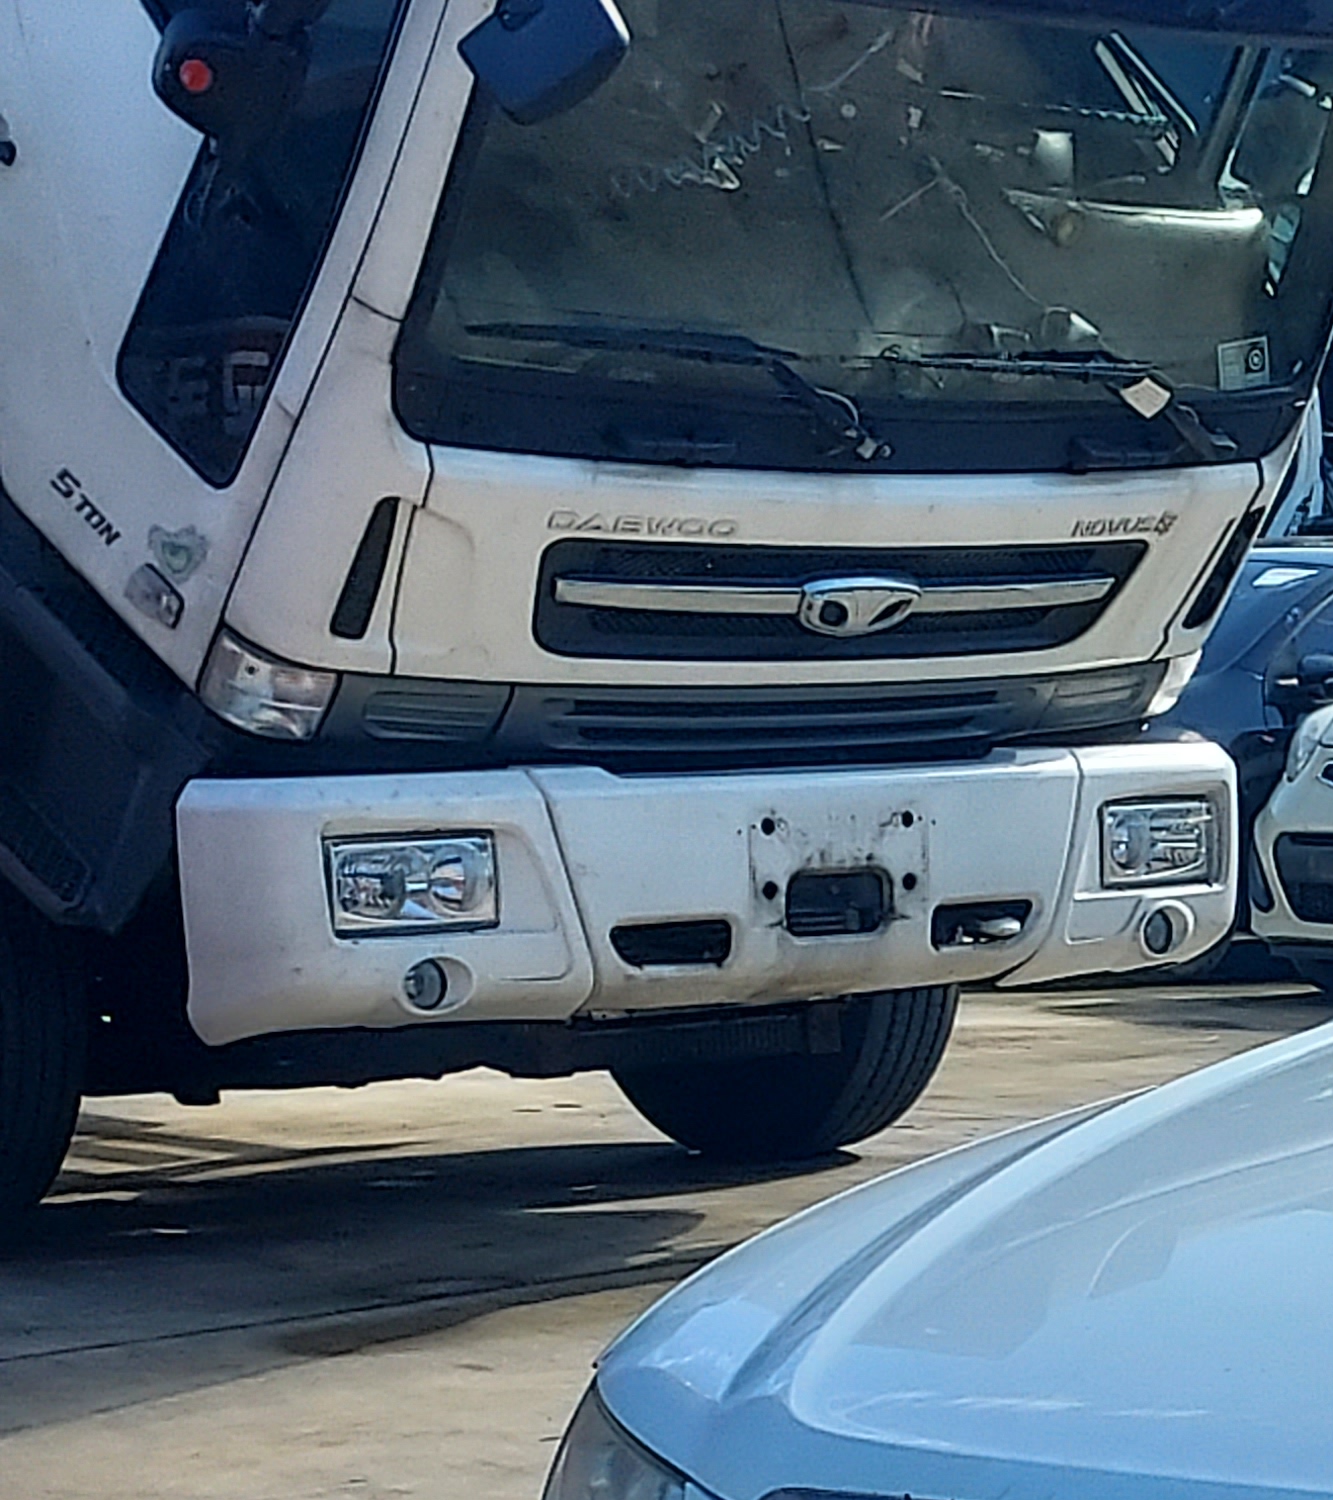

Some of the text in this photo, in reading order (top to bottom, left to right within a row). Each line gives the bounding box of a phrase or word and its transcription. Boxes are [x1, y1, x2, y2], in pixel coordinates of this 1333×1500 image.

[49, 467, 122, 547] 5 TON
[545, 509, 739, 538] DAEWOO
